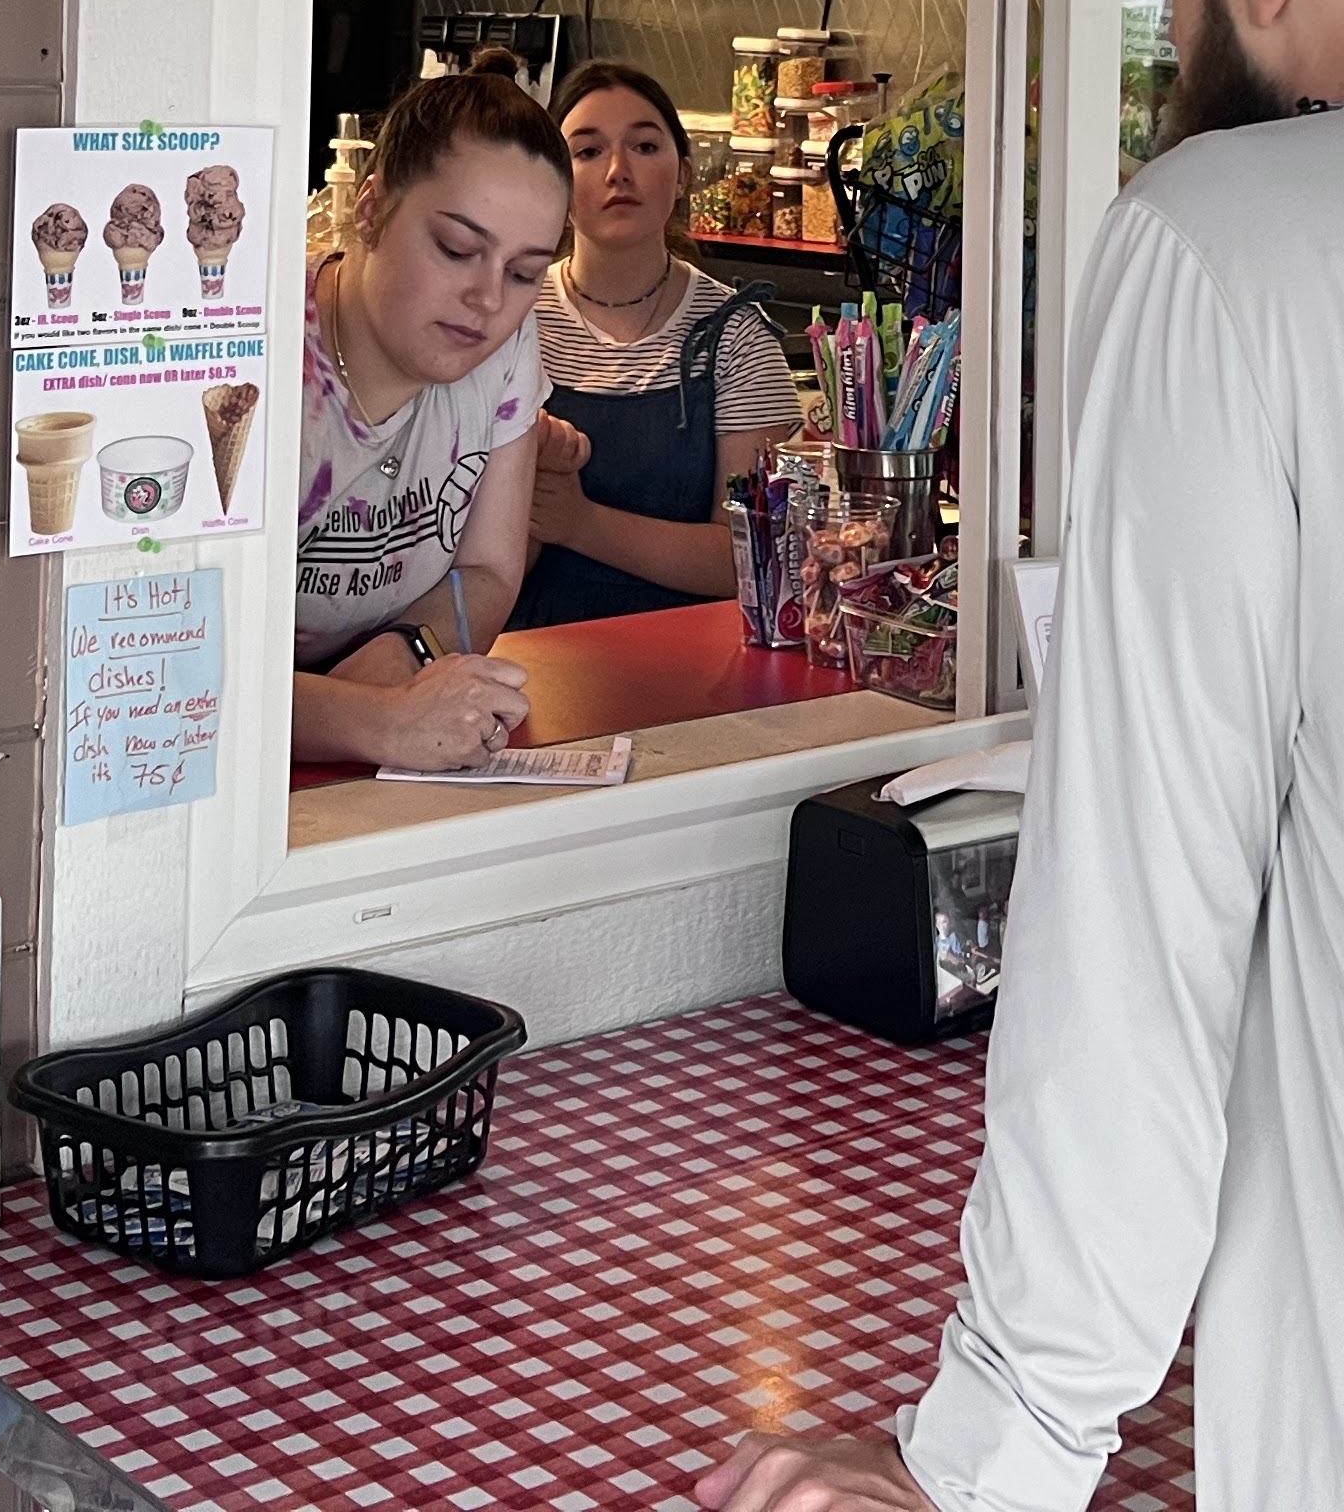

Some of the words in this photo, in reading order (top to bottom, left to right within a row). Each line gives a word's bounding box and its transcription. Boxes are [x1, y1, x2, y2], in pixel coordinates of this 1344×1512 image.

[73, 133, 118, 151] WHAT
[122, 132, 153, 151] SIZE
[158, 132, 220, 151] SCOOP?
[15, 352, 55, 372] CAKE
[58, 349, 100, 370] CONE,
[103, 346, 143, 366] DISH,
[145, 343, 166, 363] OR
[169, 341, 223, 362] WAFFLE
[226, 339, 264, 359] CONE
[43, 376, 76, 392] EXTRA
[78, 374, 108, 389] dish/
[109, 374, 137, 386] cone
[139, 372, 163, 385] now
[164, 369, 179, 383] OR
[180, 368, 206, 382] later
[208, 365, 237, 380] $0.75
[105, 585, 138, 614] It's
[148, 578, 191, 610] Hot!
[297, 567, 340, 595] Rise
[346, 568, 371, 596] As
[373, 561, 403, 590] One
[71, 625, 100, 658] We
[111, 616, 206, 649] recommend
[89, 658, 166, 693] dishes!
[68, 701, 92, 732] If
[97, 706, 120, 728] you
[129, 693, 162, 719] need
[164, 702, 181, 713] an
[185, 690, 217, 711] extra
[74, 734, 109, 762] dish
[126, 736, 156, 754] now
[163, 733, 180, 748] or
[184, 725, 217, 747] later
